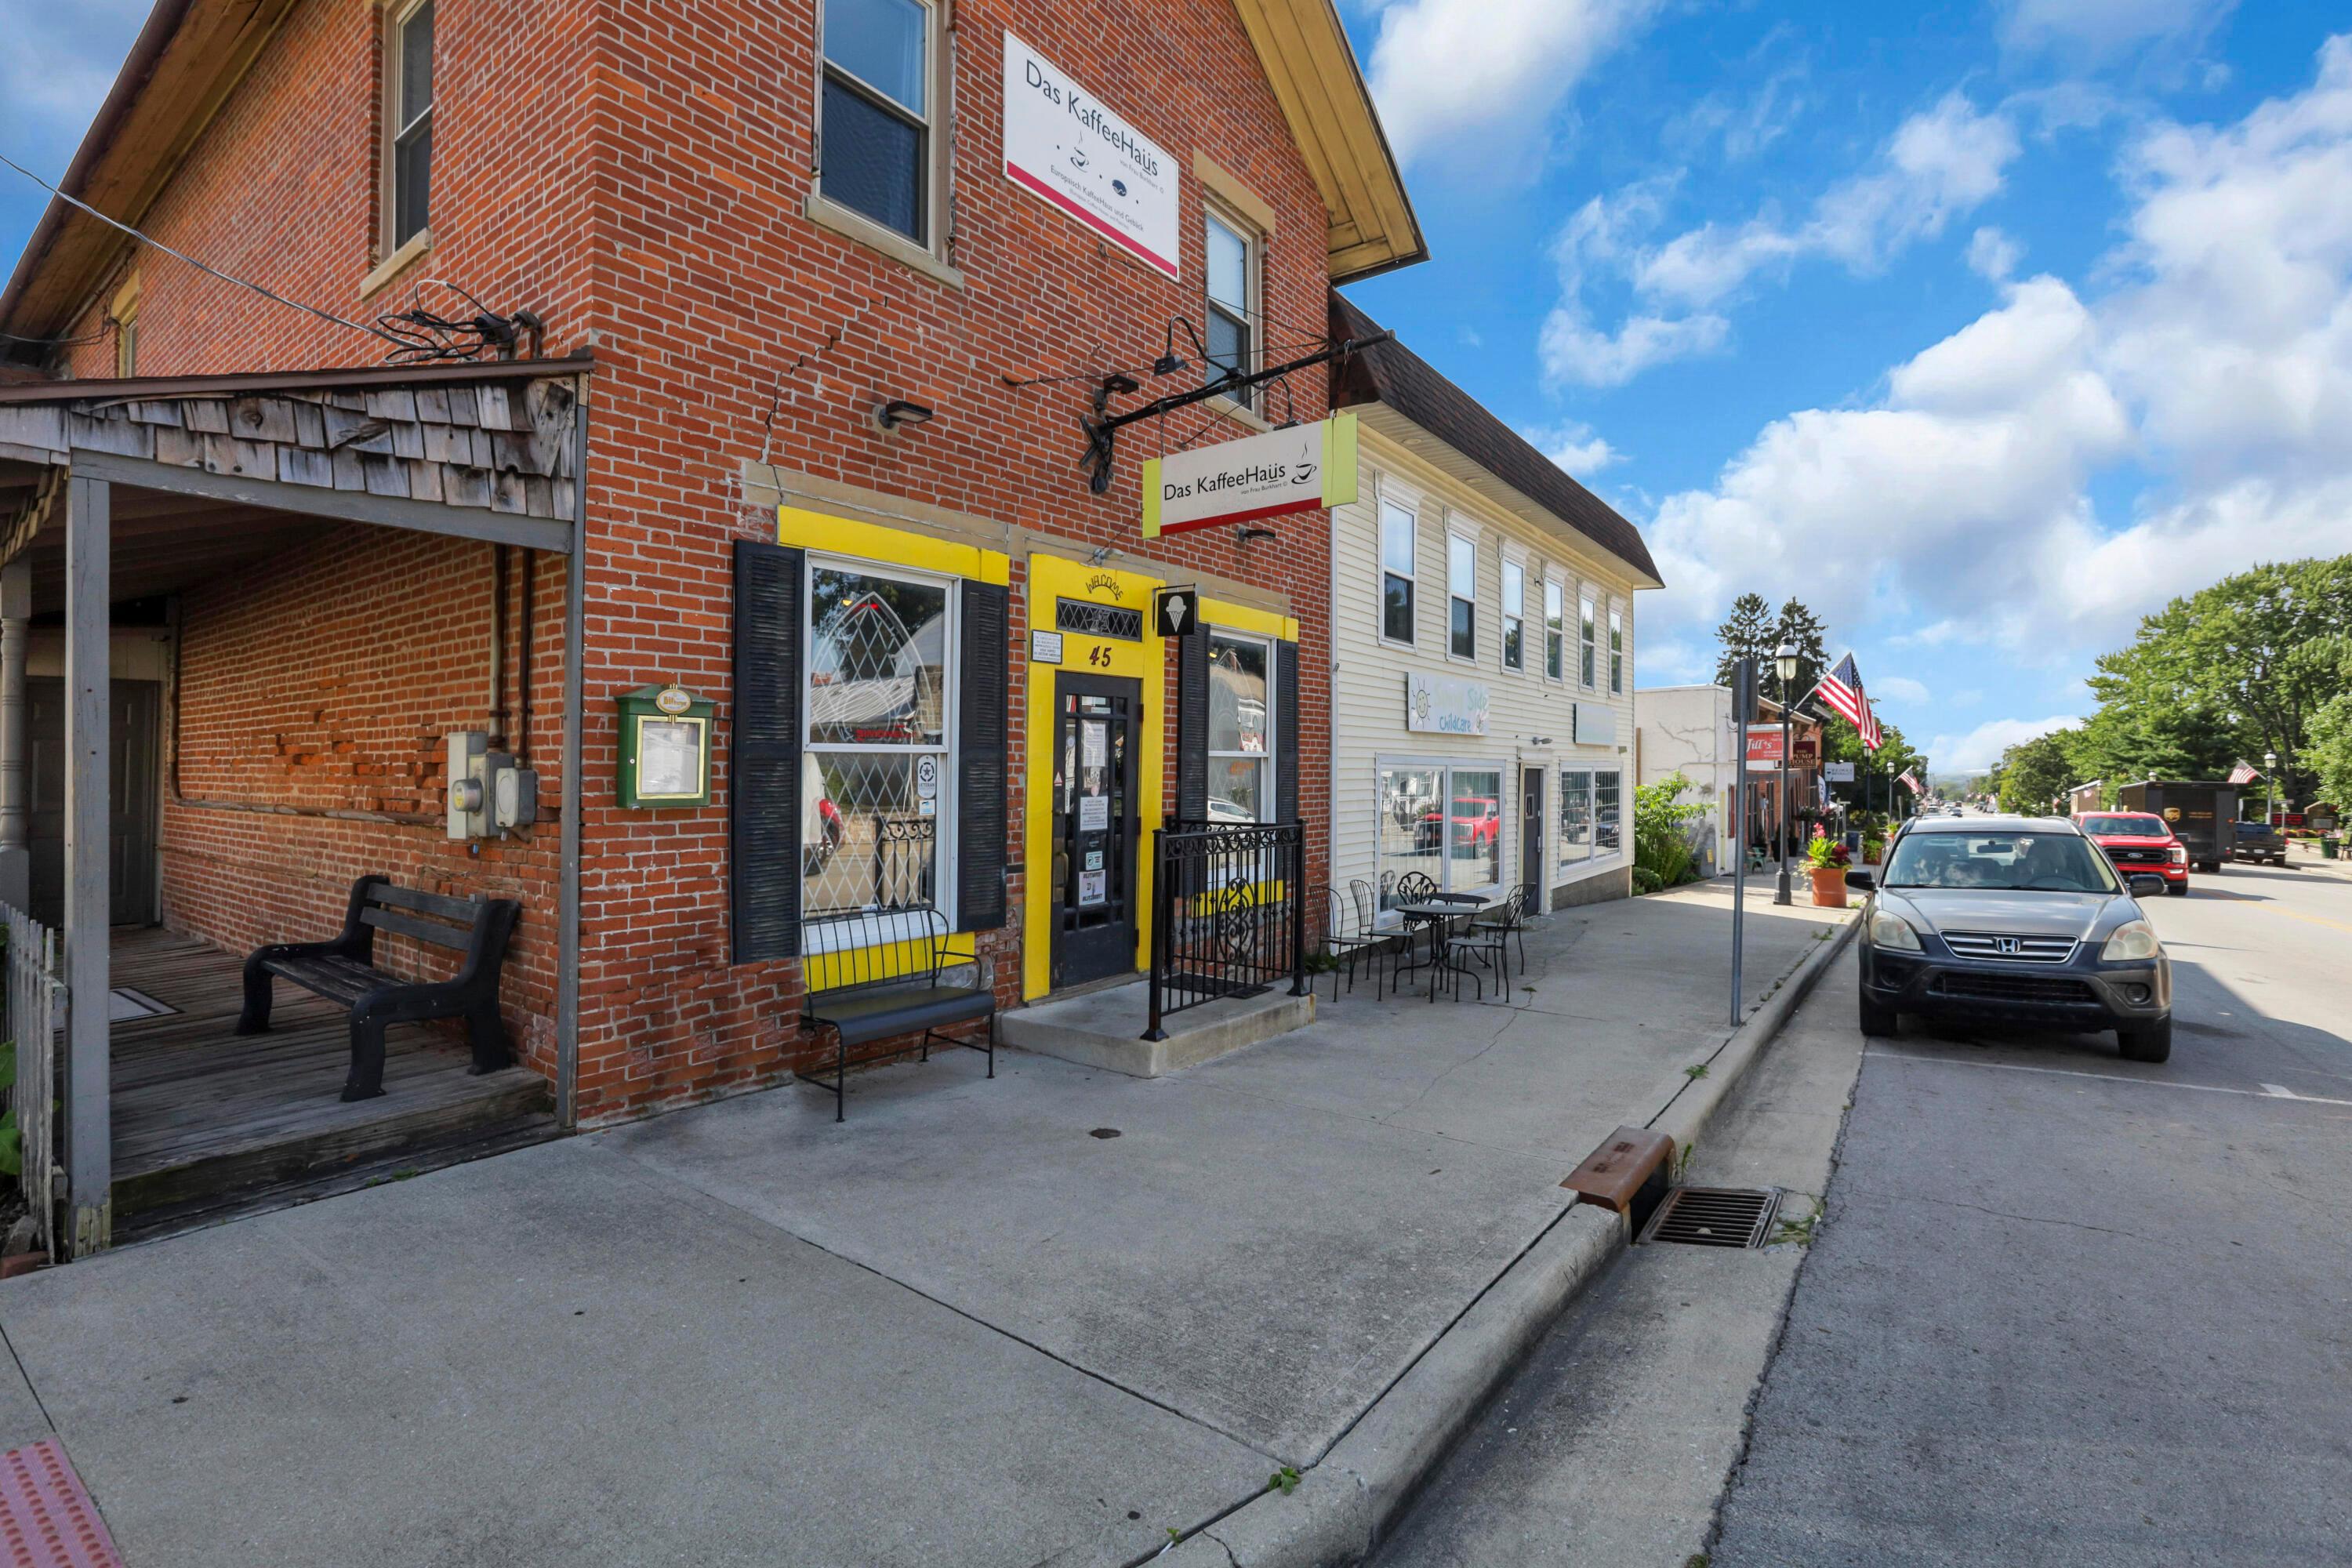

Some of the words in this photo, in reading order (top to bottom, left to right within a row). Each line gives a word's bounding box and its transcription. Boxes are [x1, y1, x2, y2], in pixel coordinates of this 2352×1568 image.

[1026, 59, 1061, 105] Das
[1069, 91, 1158, 177] KaffeeHaüs
[1114, 206, 1123, 219] und
[1164, 484, 1191, 500] Das
[1197, 463, 1286, 494] KaffeeHaüs
[1261, 482, 1282, 492] Burkhart
[1089, 645, 1112, 667] 45
